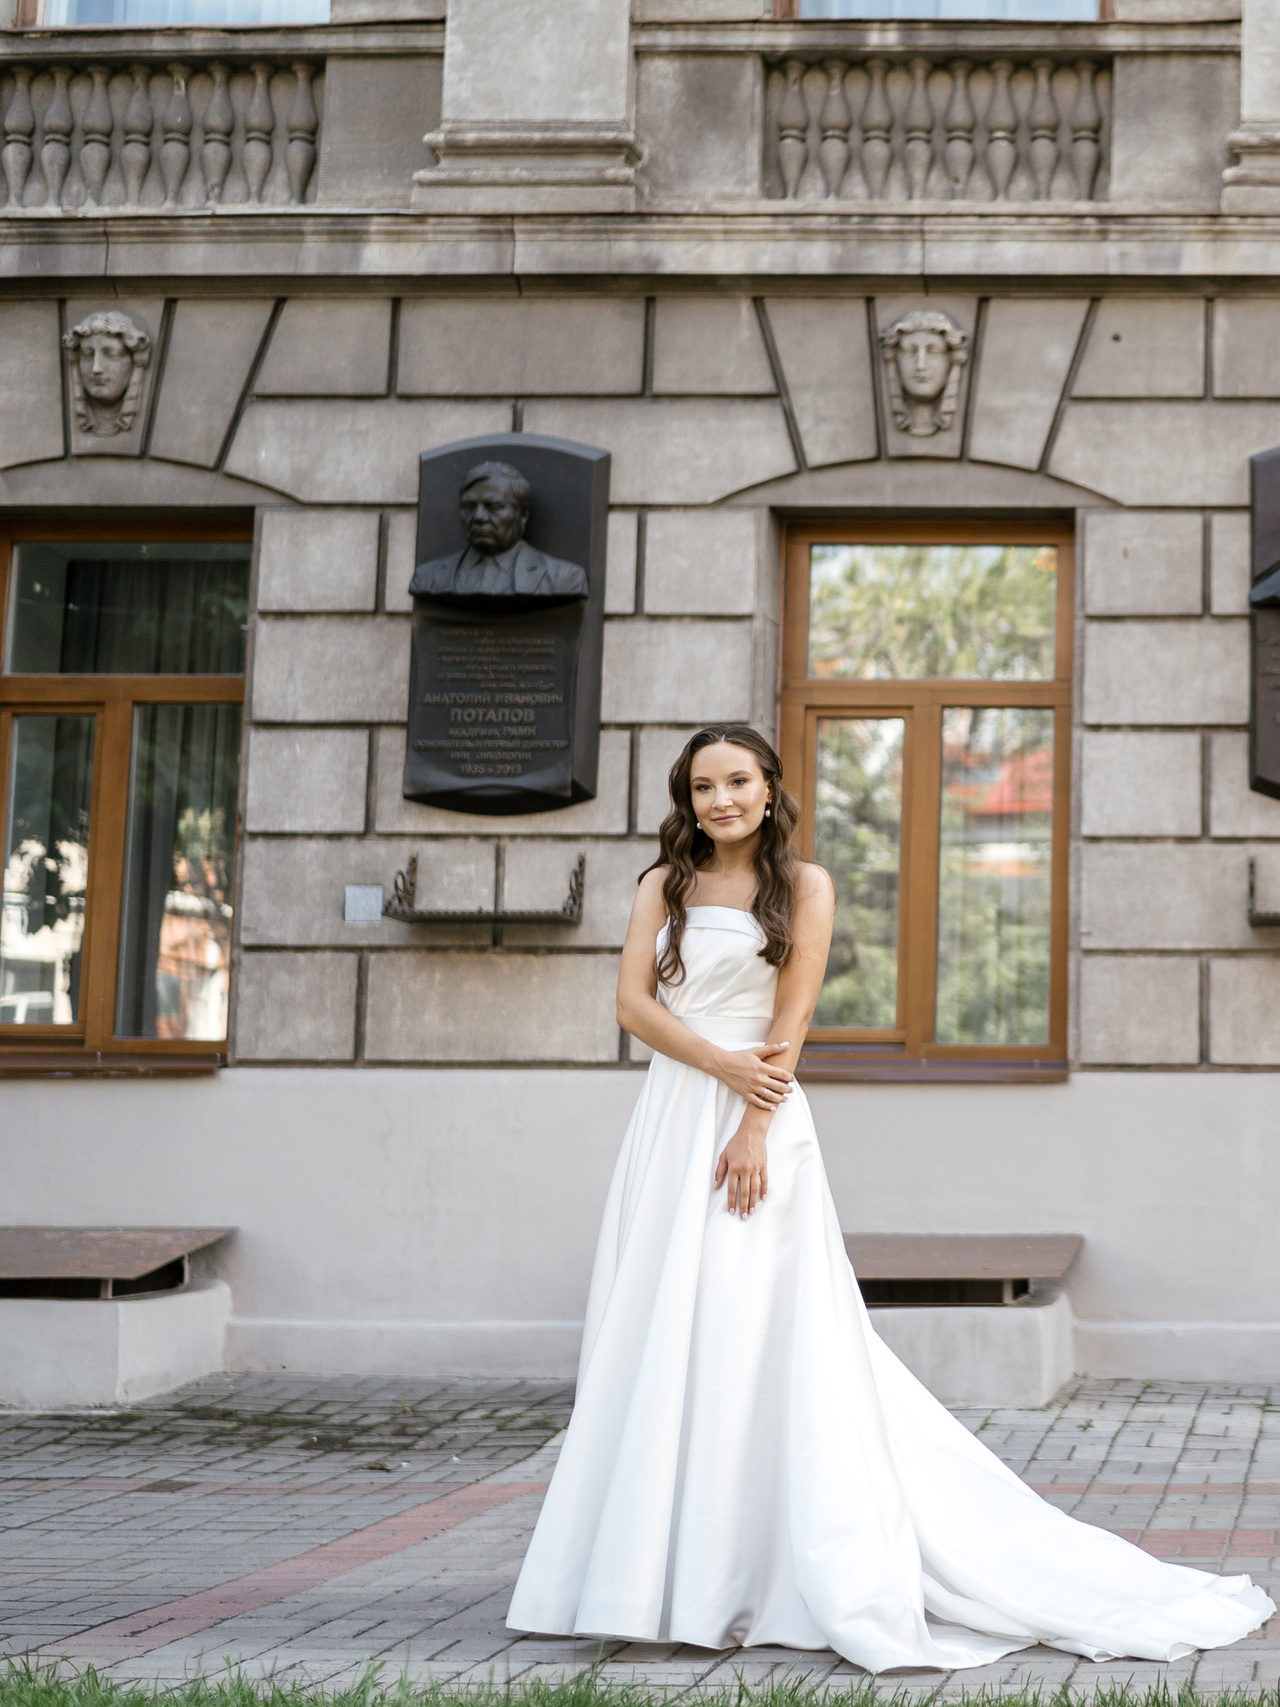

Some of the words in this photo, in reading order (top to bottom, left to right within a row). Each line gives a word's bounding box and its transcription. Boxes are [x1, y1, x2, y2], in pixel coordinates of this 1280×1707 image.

[423, 691, 490, 706] АНАТОЛИЙ
[494, 692, 563, 705] ИВАНОВИЧ
[449, 708, 535, 723] ПОТАПОВ
[448, 727, 500, 738] АКАДЕМИК
[502, 725, 536, 737] РАМН
